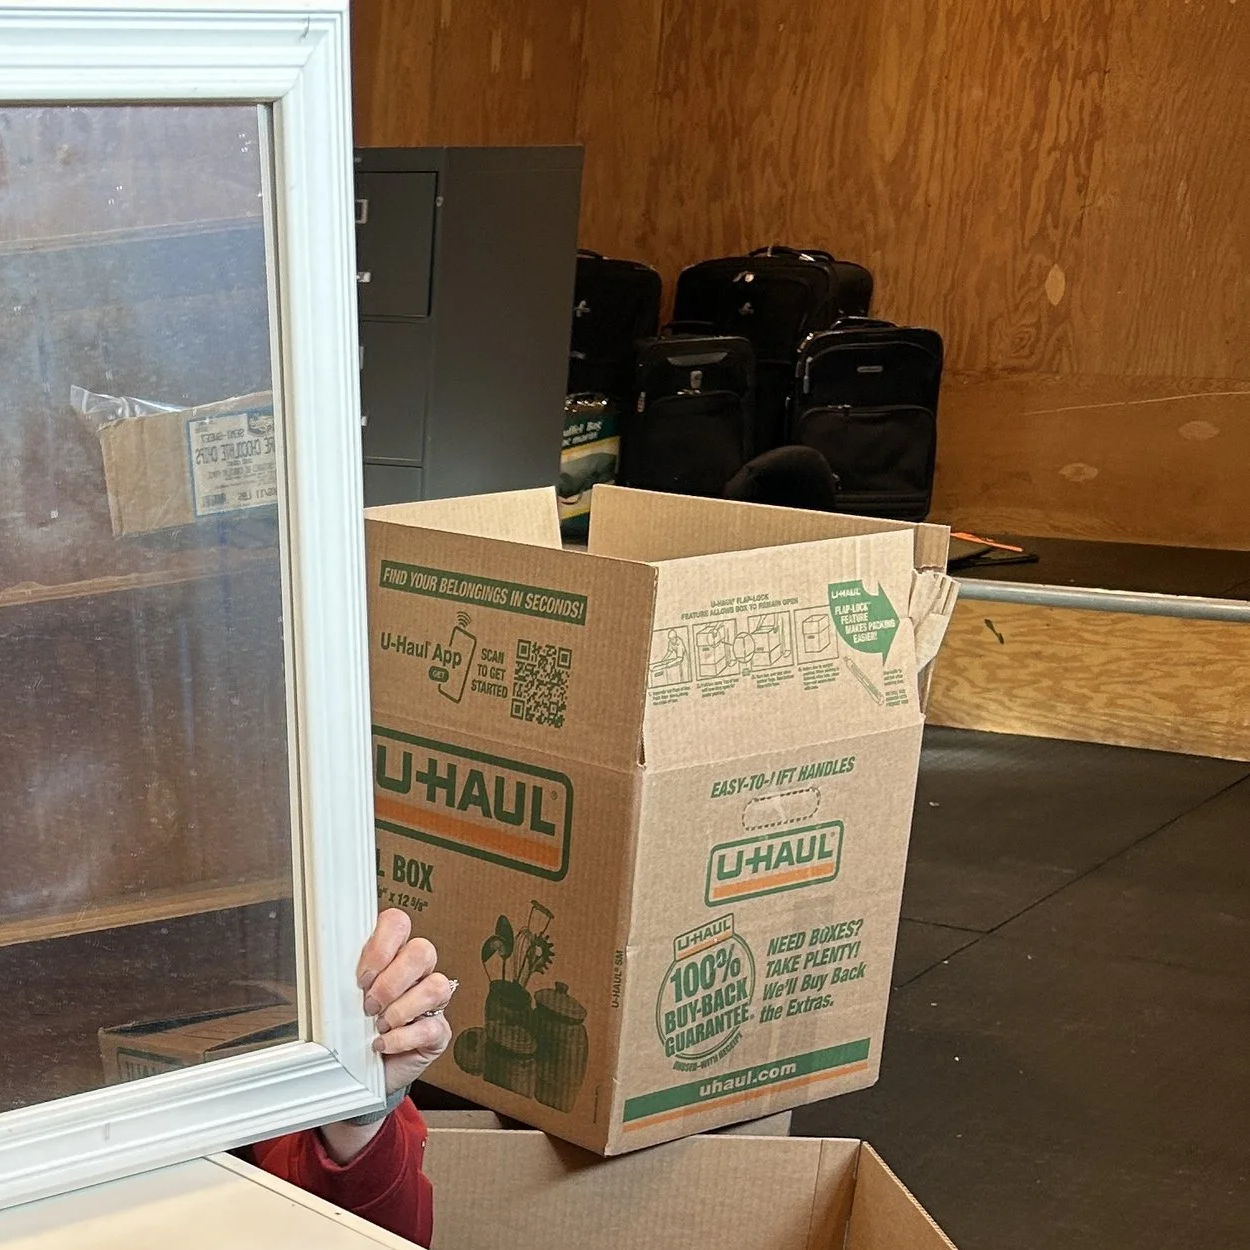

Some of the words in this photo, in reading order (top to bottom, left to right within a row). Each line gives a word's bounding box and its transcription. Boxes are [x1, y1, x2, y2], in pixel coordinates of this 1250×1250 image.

[383, 567, 407, 586] FIND
[410, 571, 438, 592] YOUR
[439, 577, 508, 604] BELONGINGS
[510, 590, 522, 608] IN
[525, 593, 584, 619] SECONDS!
[840, 612, 868, 625] FEATURE
[845, 622, 868, 635] MAKES
[869, 619, 896, 630] PACKING
[432, 644, 462, 669] App
[481, 648, 505, 664] SCAN
[432, 670, 446, 679] GET
[477, 664, 488, 677] TO
[490, 668, 506, 681] GET
[471, 681, 508, 698] STARTED
[798, 756, 856, 782] HANDLES
[393, 854, 434, 893] BOX
[398, 893, 410, 907] 12
[677, 919, 731, 951] U-HAUL
[766, 931, 806, 957] NEED
[809, 918, 864, 947] BOXES?
[617, 950, 624, 966] SM
[765, 954, 800, 978] TAKE
[803, 941, 862, 970] PLENTY!
[670, 944, 741, 1003] 100%
[763, 977, 798, 1001] We'll
[801, 972, 828, 993] Buy
[831, 961, 867, 984] Back
[664, 977, 748, 1035] BUY-BACK
[759, 1002, 783, 1024] the
[786, 993, 834, 1017] Extras.
[699, 1061, 797, 1097] uhaul.com
